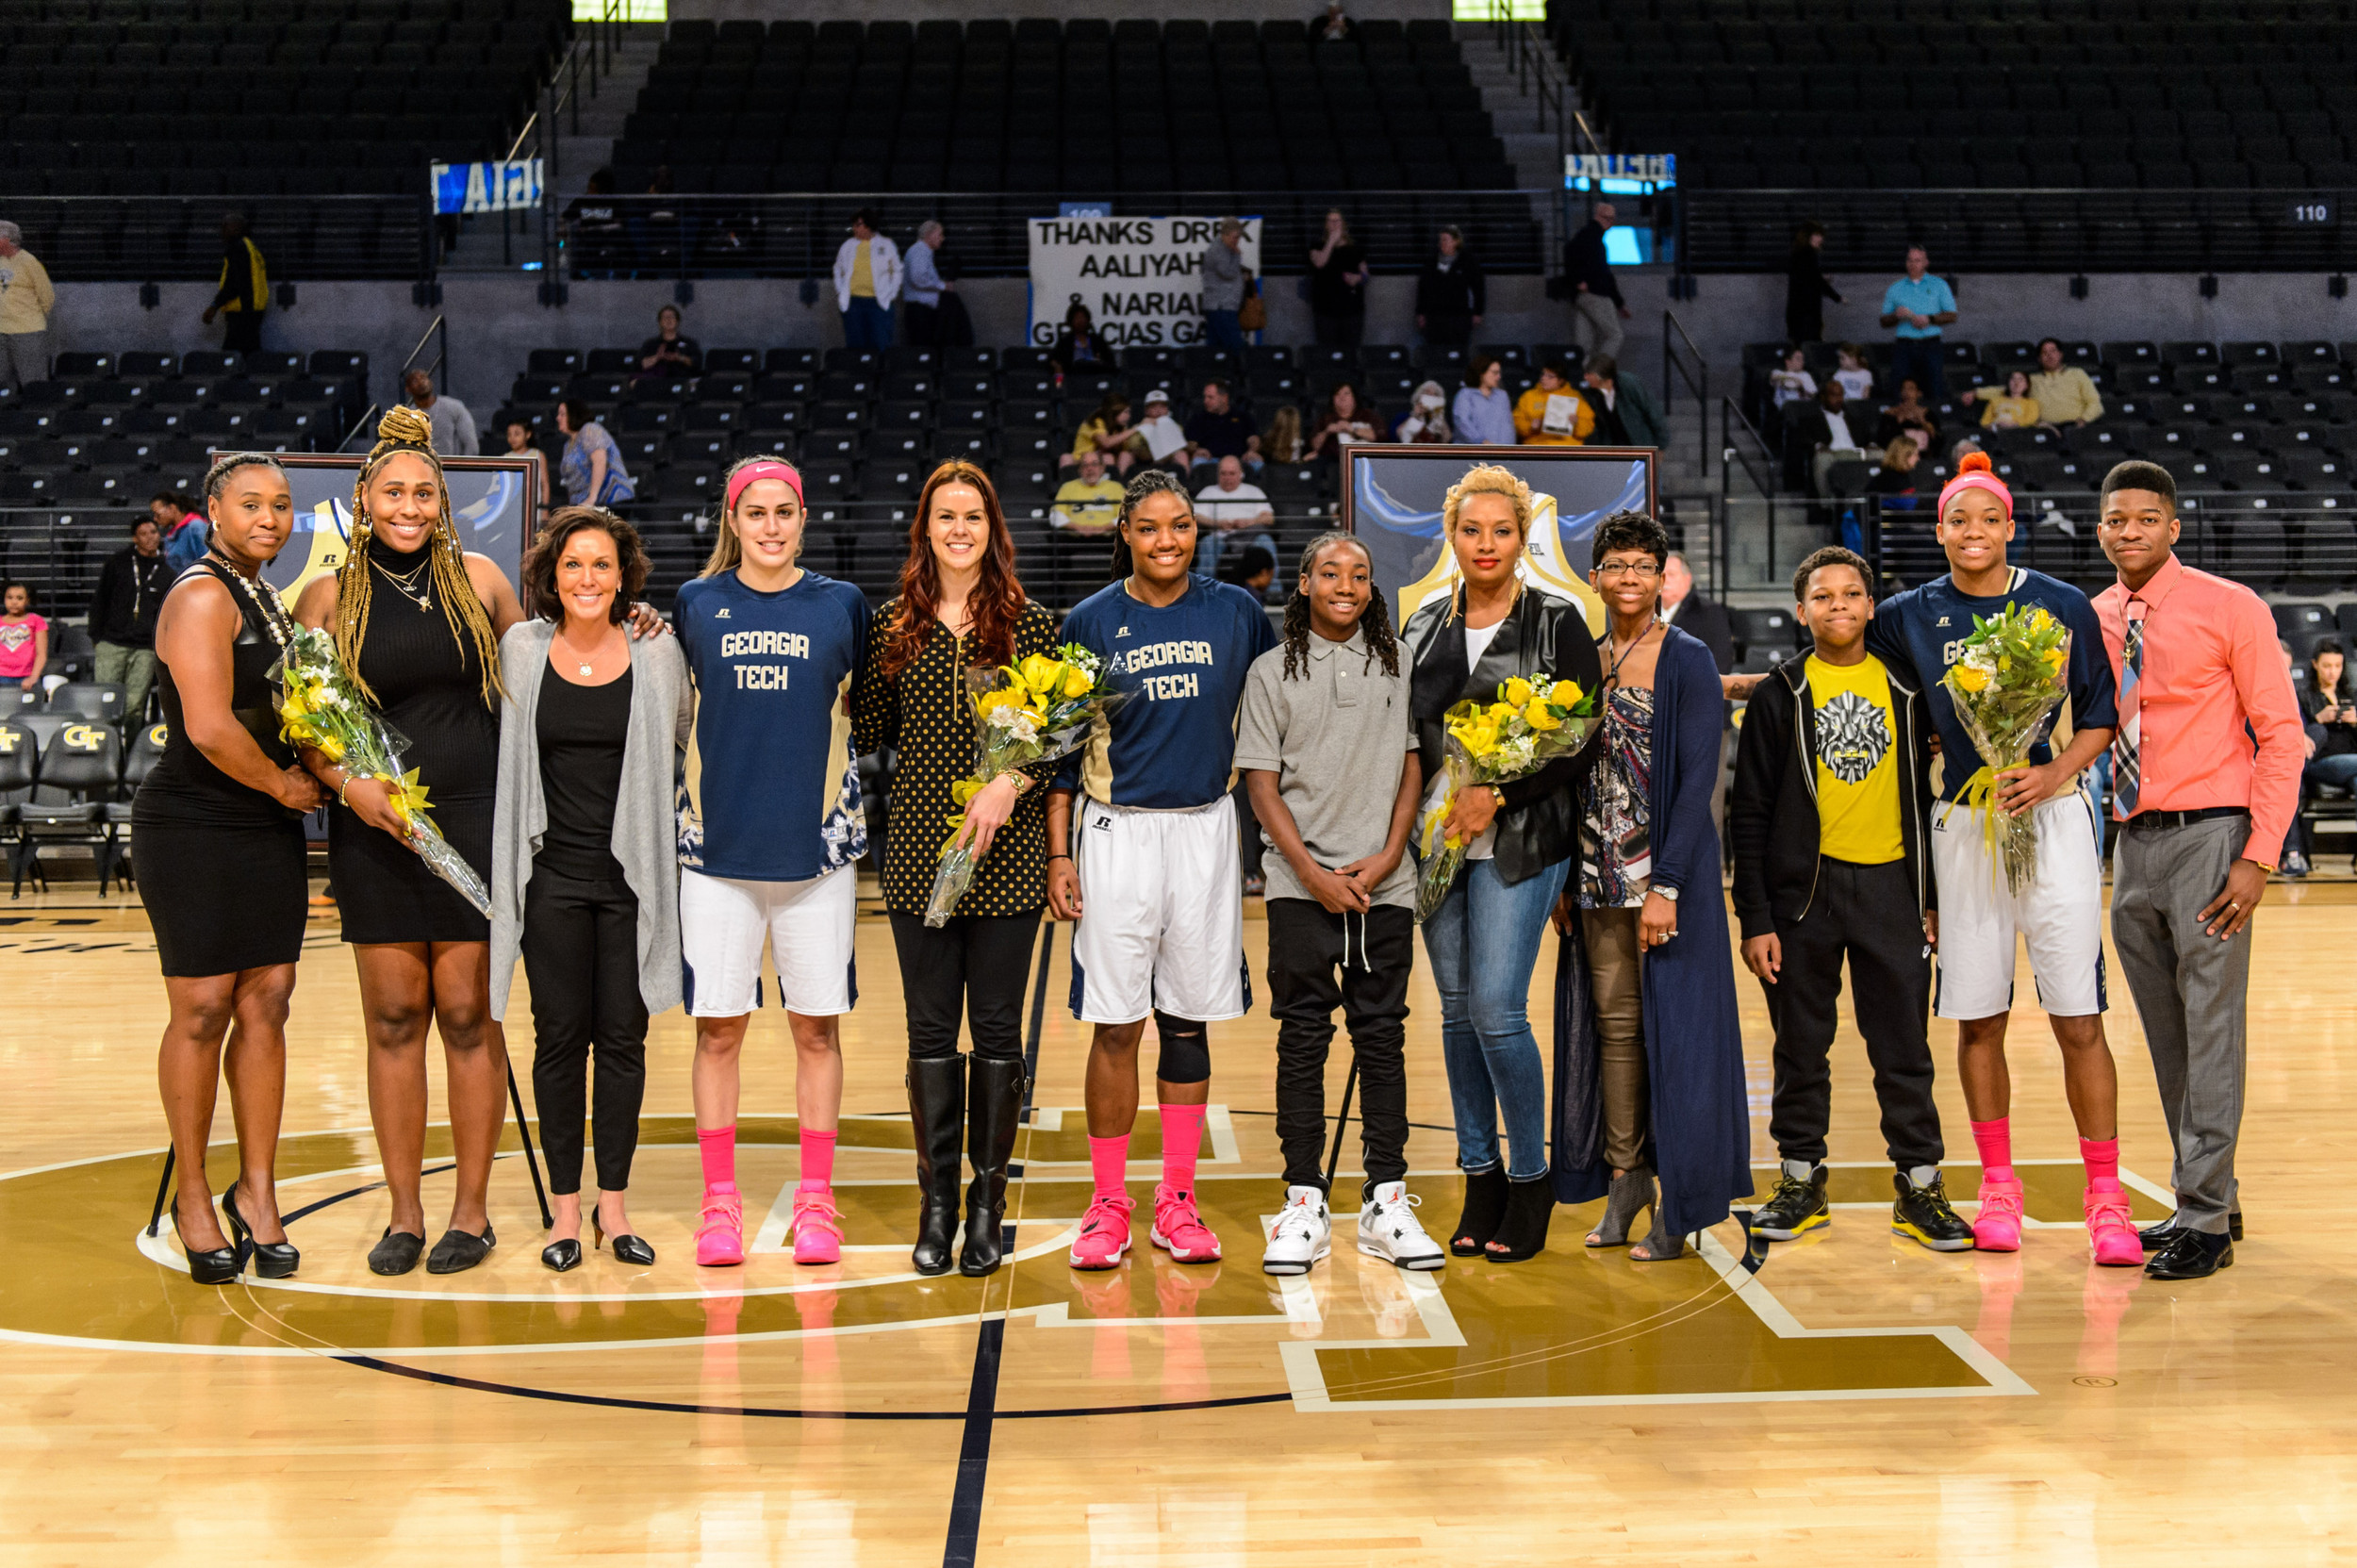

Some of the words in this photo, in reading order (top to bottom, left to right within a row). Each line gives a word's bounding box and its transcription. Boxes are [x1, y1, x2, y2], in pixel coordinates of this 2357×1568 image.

[2295, 205, 2328, 222] 110
[1036, 221, 1154, 244] THANKS
[1080, 252, 1203, 277] AALIYAH
[1033, 321, 1162, 346] GRCIAS
[721, 631, 809, 660] GEORGIA
[1127, 640, 1213, 674] GEORGIA
[733, 665, 788, 690] TECH
[1143, 672, 1199, 701] TECH
[63, 725, 106, 751] GT
